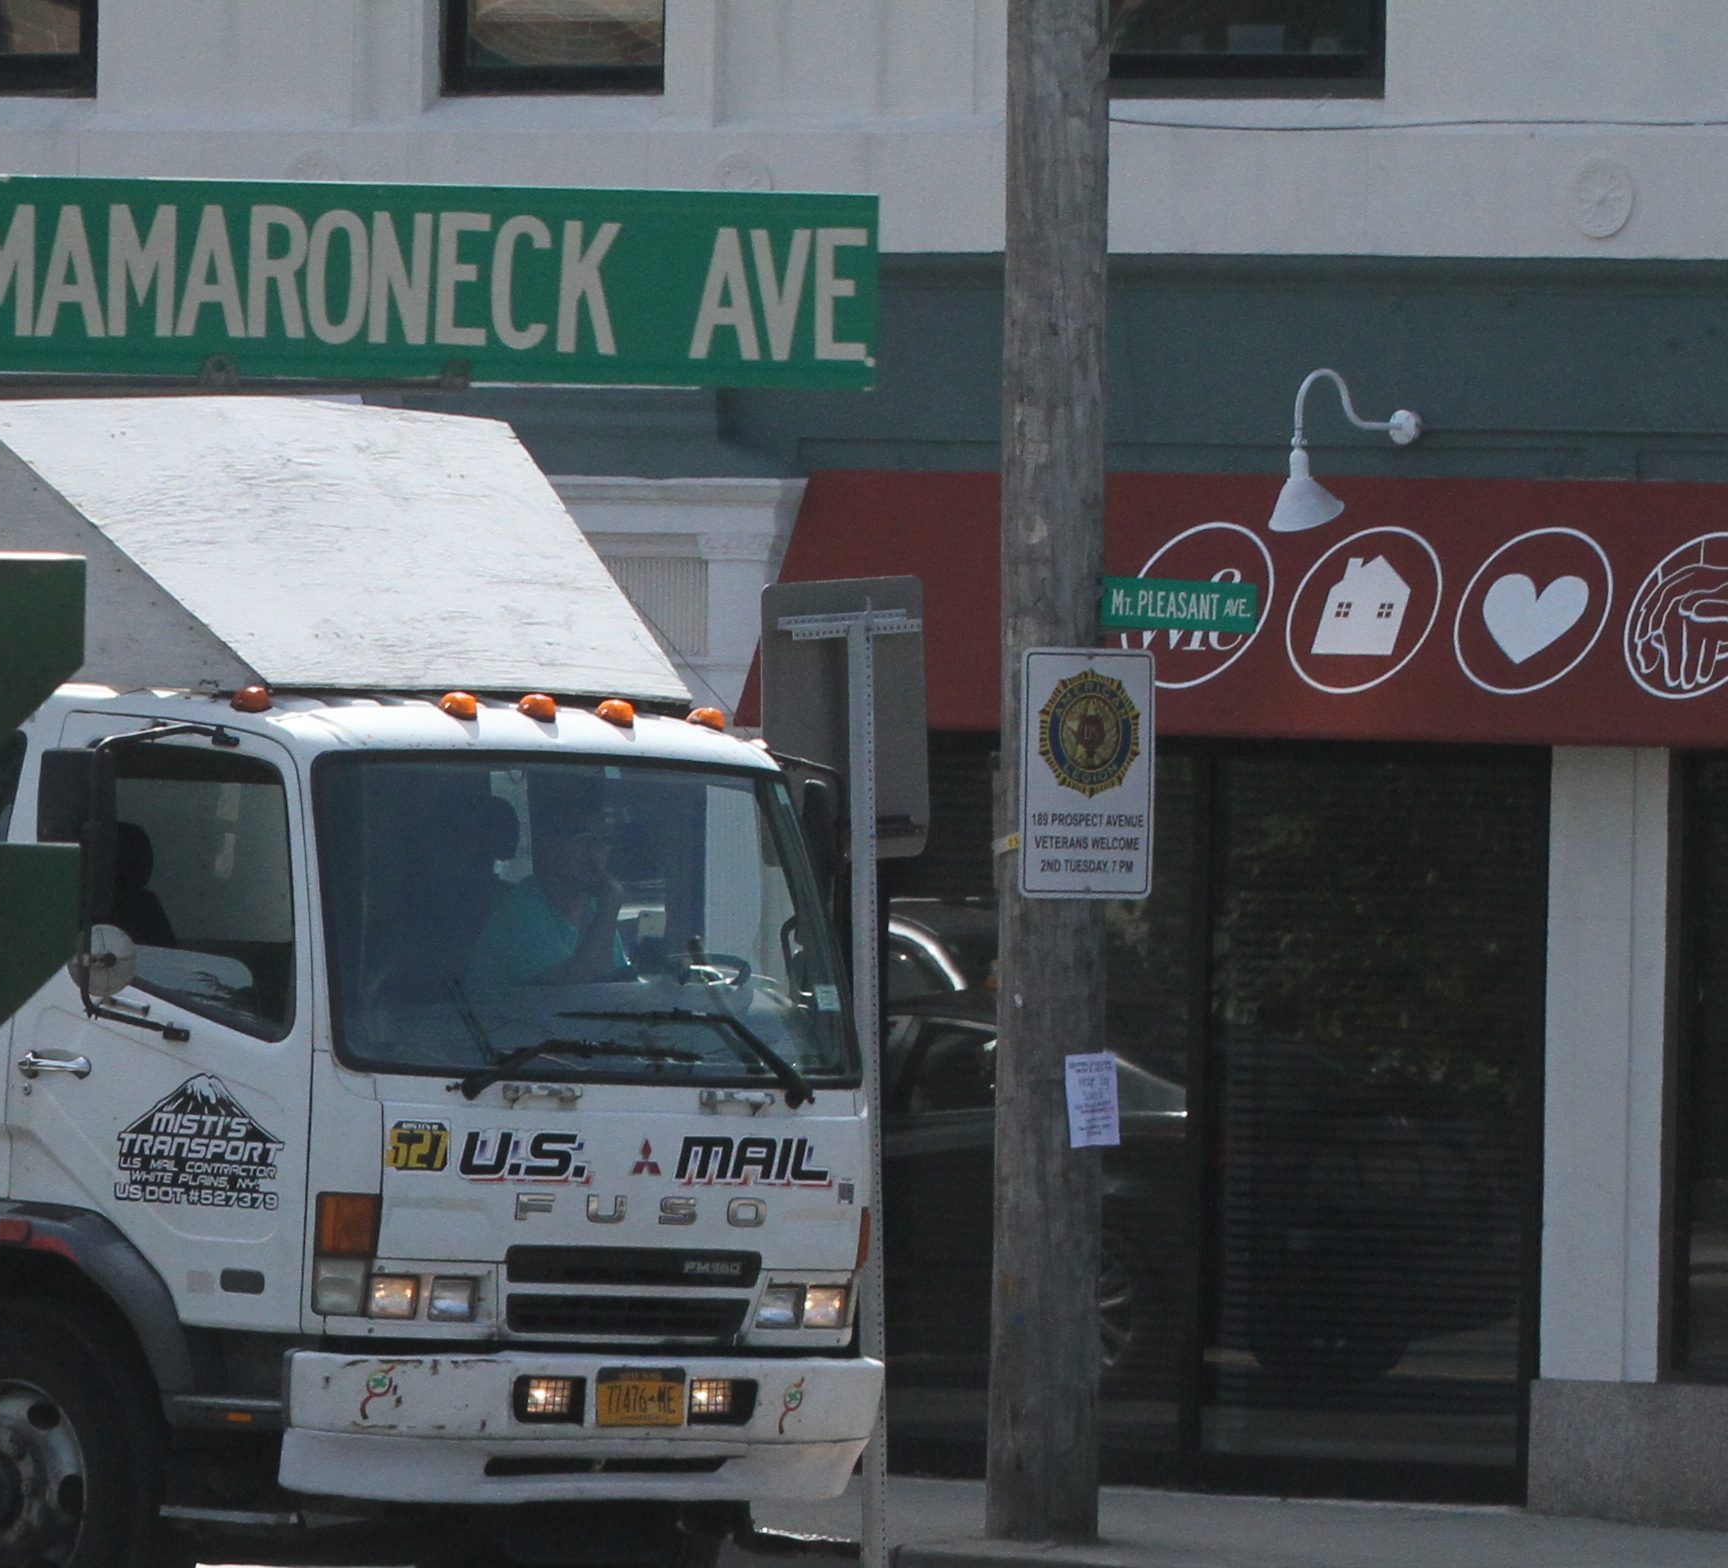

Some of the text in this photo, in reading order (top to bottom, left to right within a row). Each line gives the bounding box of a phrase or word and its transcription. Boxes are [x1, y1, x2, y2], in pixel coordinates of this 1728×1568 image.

[1137, 590, 1221, 621] PLEASANT
[1223, 598, 1252, 618] AVE.
[1051, 813, 1104, 828] PROSPECT
[1105, 814, 1144, 829] AVENUE
[1034, 836, 1089, 850] VETERANS
[1091, 837, 1140, 851] WELCOME
[1040, 859, 1061, 873] 2ND
[1111, 860, 1118, 873] 7
[1119, 860, 1134, 873] PM
[150, 1112, 250, 1138] MISTI'S
[119, 1132, 284, 1164] TRANSPORT
[386, 1128, 452, 1169] 527
[457, 1130, 833, 1186] U.S. MAIL
[131, 1171, 173, 1184] WHITE
[178, 1174, 230, 1190] PLAINS,
[150, 1159, 178, 1171] MAIL
[185, 1161, 278, 1180] CONTRACTOR
[115, 1183, 279, 1209] US DOT #527379
[515, 1192, 769, 1229] FUSO
